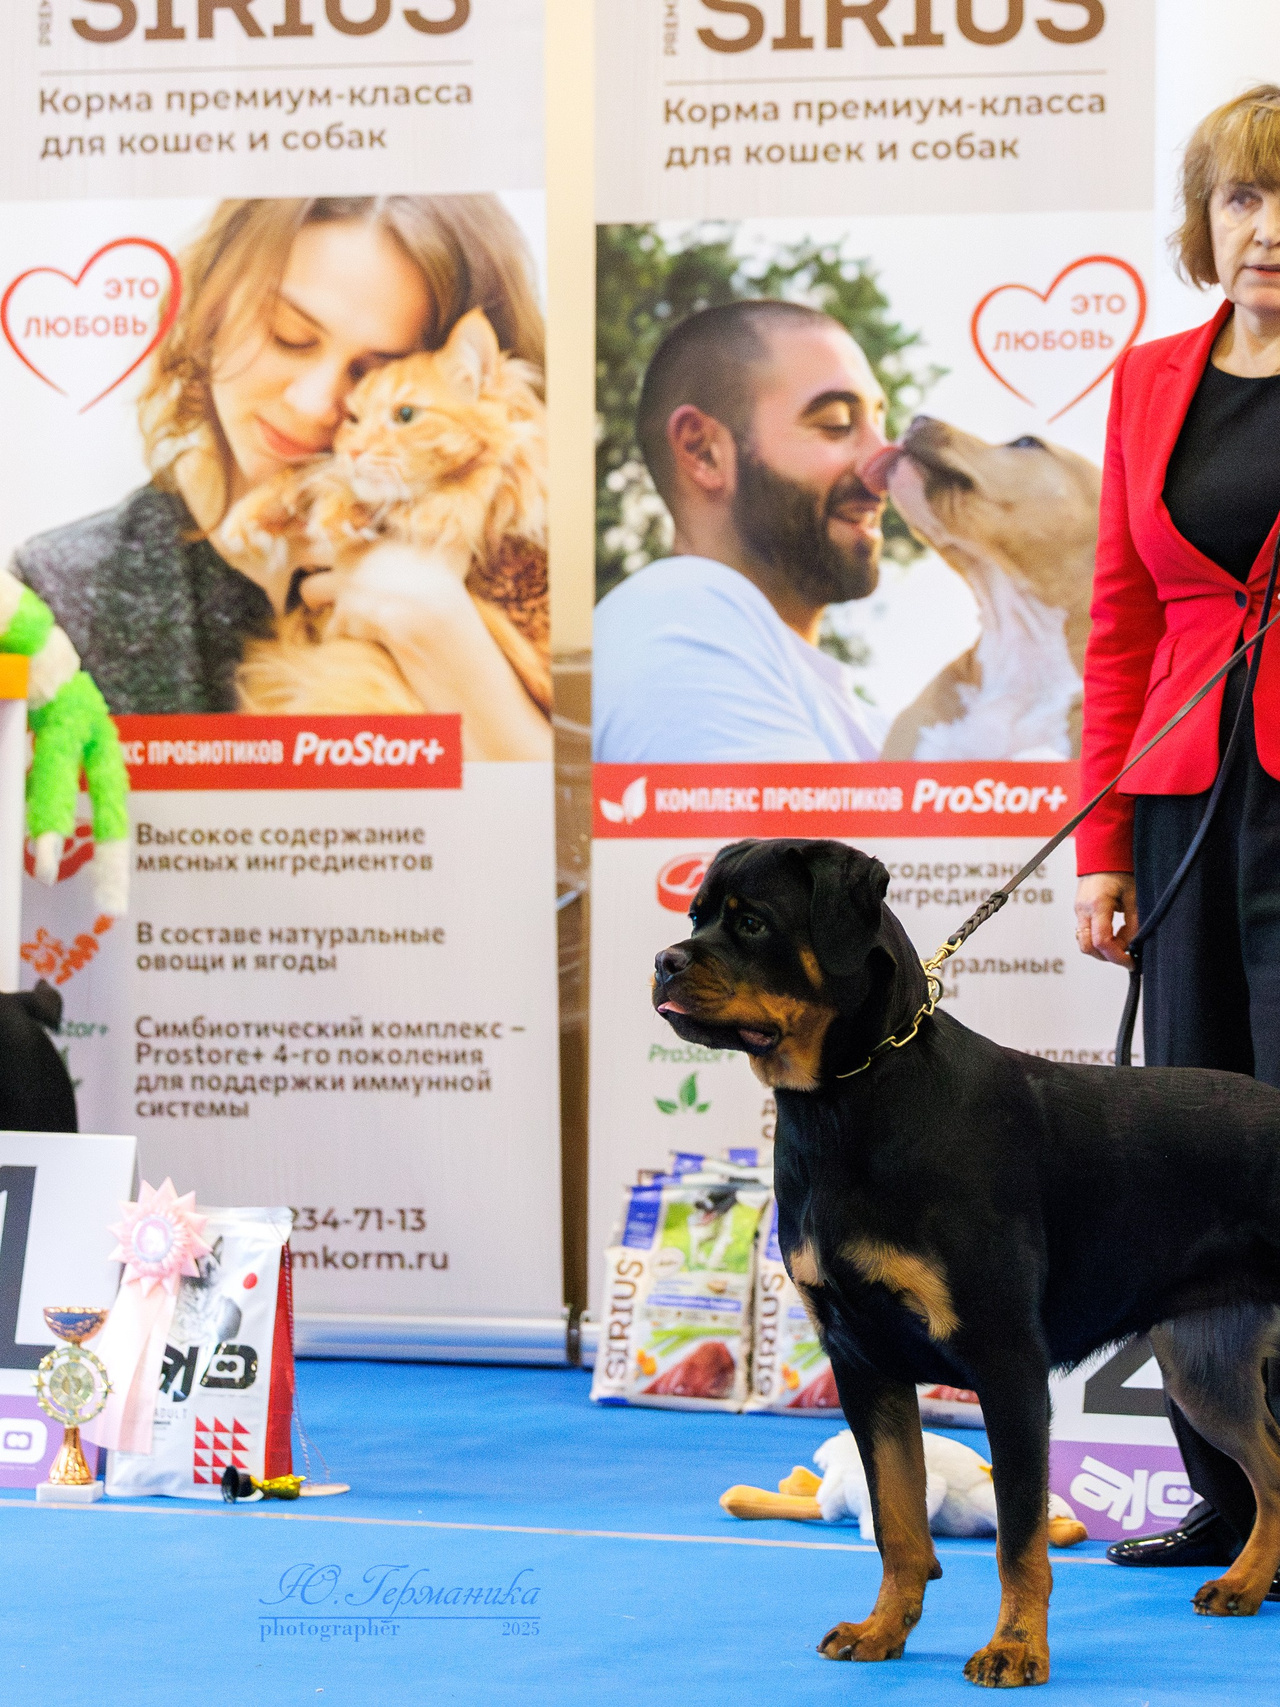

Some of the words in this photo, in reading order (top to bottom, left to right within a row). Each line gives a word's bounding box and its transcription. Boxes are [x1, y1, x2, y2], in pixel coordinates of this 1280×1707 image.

[39, 87, 153, 118] Корма
[166, 82, 473, 117] премиум-класса
[664, 98, 780, 130] Корма
[793, 89, 1107, 125] премиум-класса
[40, 133, 105, 159] для
[119, 131, 236, 155] кошек
[248, 132, 269, 151] и
[281, 123, 388, 152] собак
[666, 142, 731, 170] для
[745, 139, 864, 164] кошек
[877, 140, 898, 161] и
[911, 132, 1020, 160] собак
[104, 277, 160, 299] ЭТО
[1070, 293, 1127, 315] ЭТО
[24, 315, 148, 339] ЛЮБОВЬ
[992, 330, 1114, 353] ЛЮБОВЬ
[147, 739, 284, 765] ПРОБИОТИКОВ
[292, 732, 444, 767] ProStor+
[655, 787, 759, 813] КОМПЛЕКС
[762, 786, 903, 812] ПРОБИОТИКОВ
[911, 779, 1068, 813] ProStor+
[136, 823, 253, 846] Высокое
[260, 824, 425, 852] содержание
[136, 854, 239, 873] мясных
[246, 852, 433, 877] ингредиентов
[136, 923, 153, 944] В
[161, 927, 261, 945] составе
[268, 926, 445, 950] натуральные
[137, 953, 226, 974] овощи
[233, 954, 246, 971] и
[253, 952, 337, 976] ягоды
[135, 1015, 364, 1041] Симбиотический
[372, 1019, 503, 1039] комплекс
[136, 1044, 263, 1067] Prostore+
[272, 1044, 331, 1066] 4-го
[337, 1046, 483, 1067] поколения
[135, 1073, 187, 1096] для
[190, 1073, 345, 1097] поддержки
[352, 1067, 491, 1093] иммунной
[136, 1100, 249, 1119] системы
[605, 1257, 644, 1381] SIRIUS
